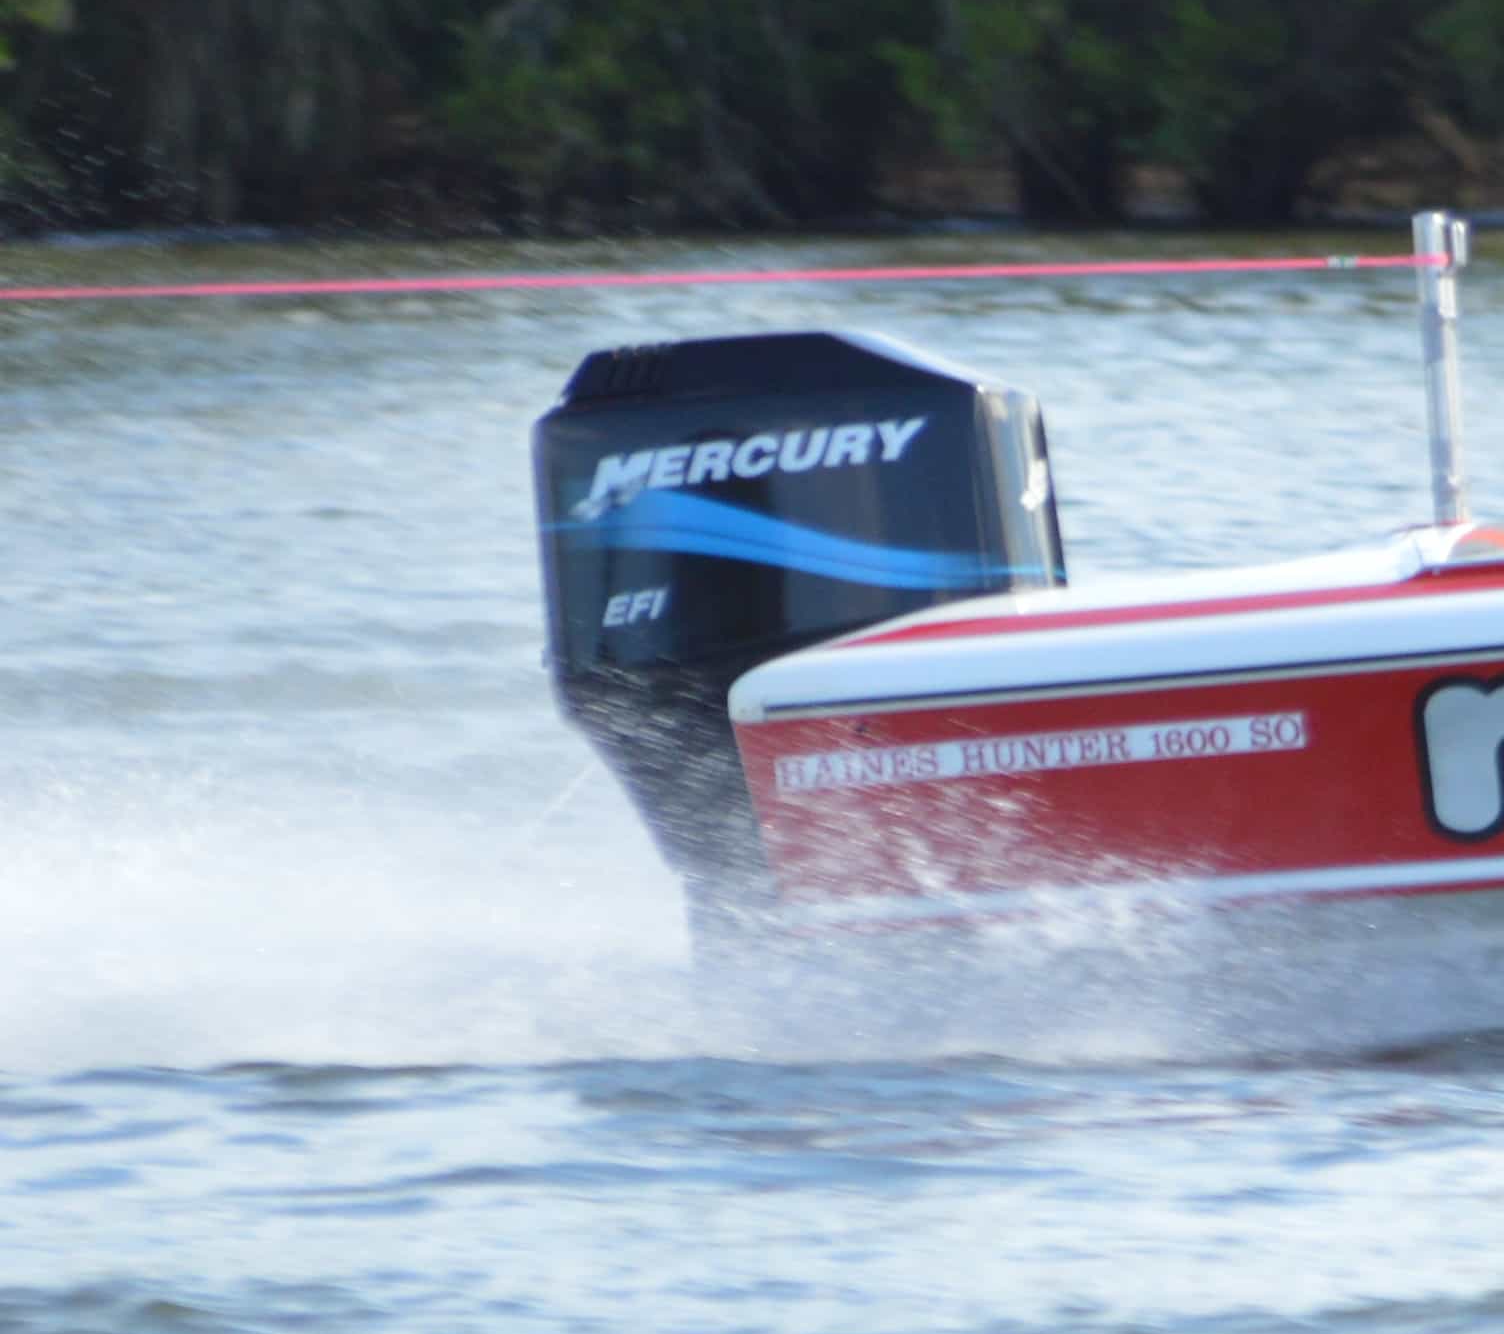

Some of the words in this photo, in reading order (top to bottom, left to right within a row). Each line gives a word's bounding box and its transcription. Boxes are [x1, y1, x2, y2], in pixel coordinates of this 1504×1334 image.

[582, 416, 927, 509] MERCURY
[601, 587, 670, 628] EFI
[777, 747, 939, 791] HAINES
[960, 728, 1132, 777] HUNTER
[1150, 723, 1231, 759] 1600
